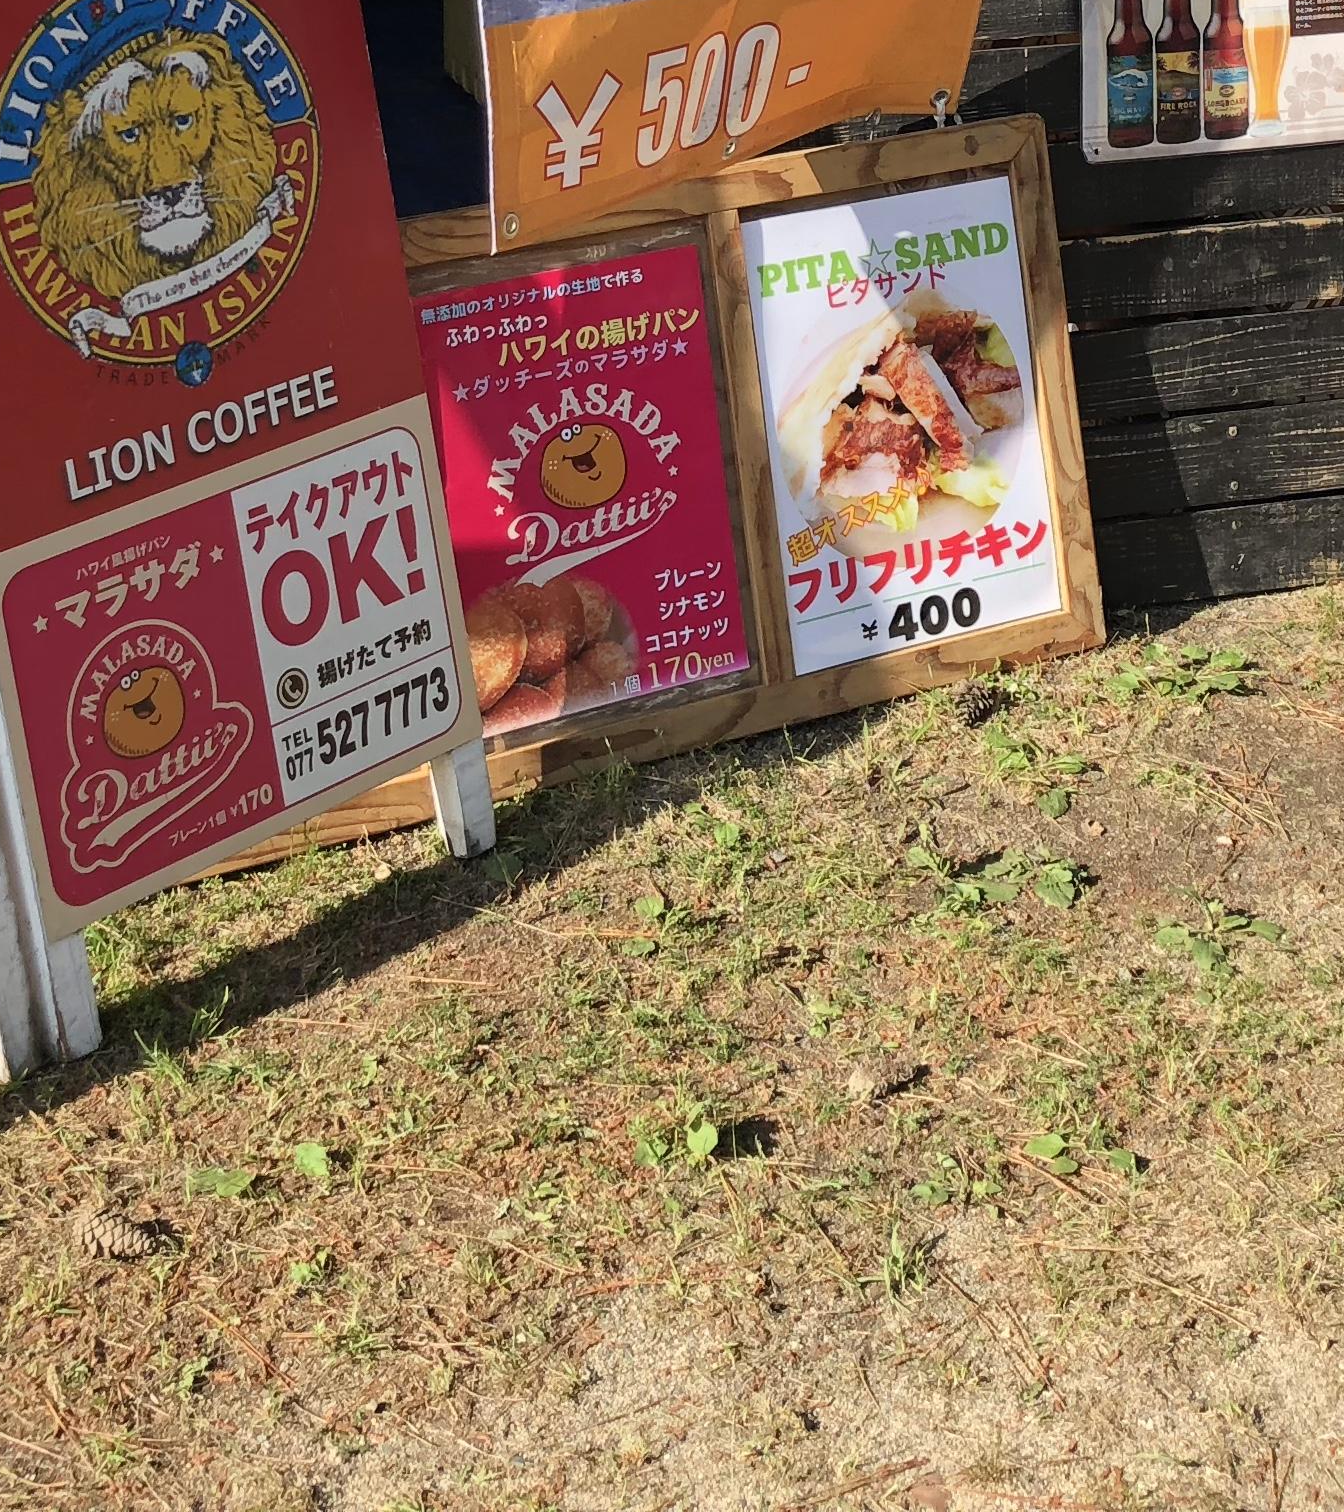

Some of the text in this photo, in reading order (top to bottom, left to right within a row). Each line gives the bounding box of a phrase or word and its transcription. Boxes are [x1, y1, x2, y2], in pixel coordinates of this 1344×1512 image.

[79, 32, 158, 93] LION COFFEE
[757, 222, 1010, 299] PITA SAND
[826, 263, 947, 310] ピタサンド
[420, 268, 644, 326] 無添加のオリジナルの生地で作る
[94, 317, 273, 387] TRADE MARK
[445, 312, 549, 349] ふわっふわっ
[498, 307, 701, 369] ハワイの揚げパン
[64, 365, 339, 503] LION COFFEE
[486, 383, 684, 506] MALASADA
[245, 450, 414, 555] テイクアウト
[55, 540, 203, 630] マラサダ
[75, 534, 171, 582] ハワイ風揚げパン
[260, 503, 428, 648] OK!
[654, 560, 723, 593] プレーン
[788, 518, 1049, 615] フリフリチキン
[645, 618, 730, 654] ココナッツ
[658, 589, 726, 622] シナモン
[78, 633, 197, 724] MALASADA
[316, 618, 433, 690] 揚げたて予約
[282, 727, 315, 750] TEL
